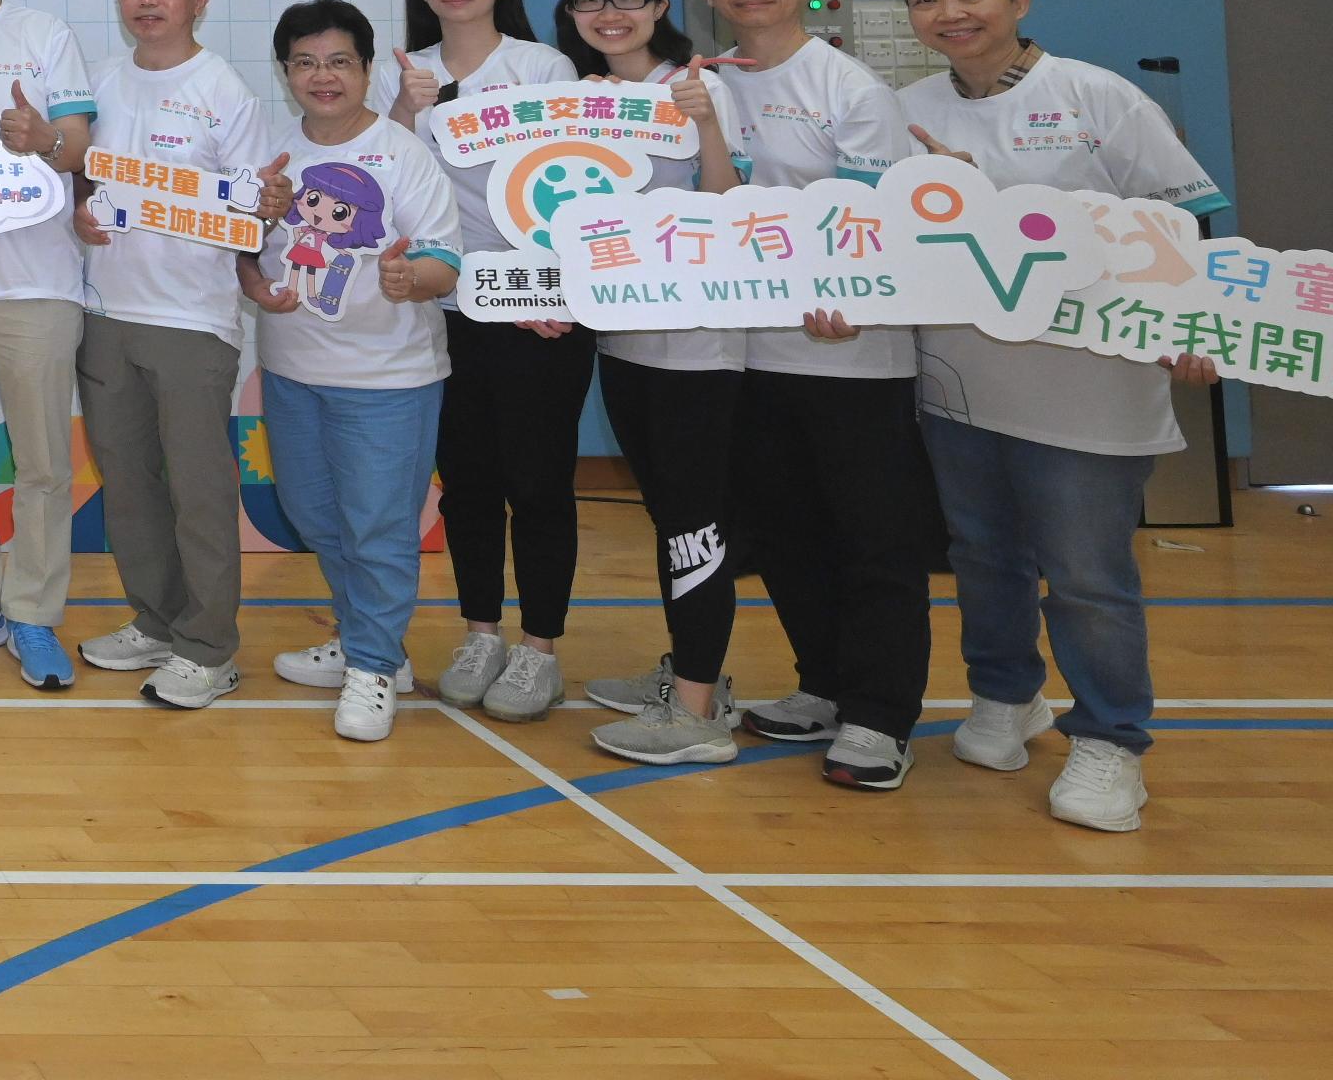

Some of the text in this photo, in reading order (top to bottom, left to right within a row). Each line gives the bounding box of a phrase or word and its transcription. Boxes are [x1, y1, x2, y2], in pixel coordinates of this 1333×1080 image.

[447, 96, 690, 139] 持份者交流活動
[457, 124, 682, 154] Stakeholder Engagement
[89, 151, 201, 199] 保護兒童
[140, 199, 259, 250] 全城起動
[579, 205, 883, 271] 童行有你
[590, 274, 897, 304] WALK WITH KIDS
[668, 522, 721, 572] NIKE
